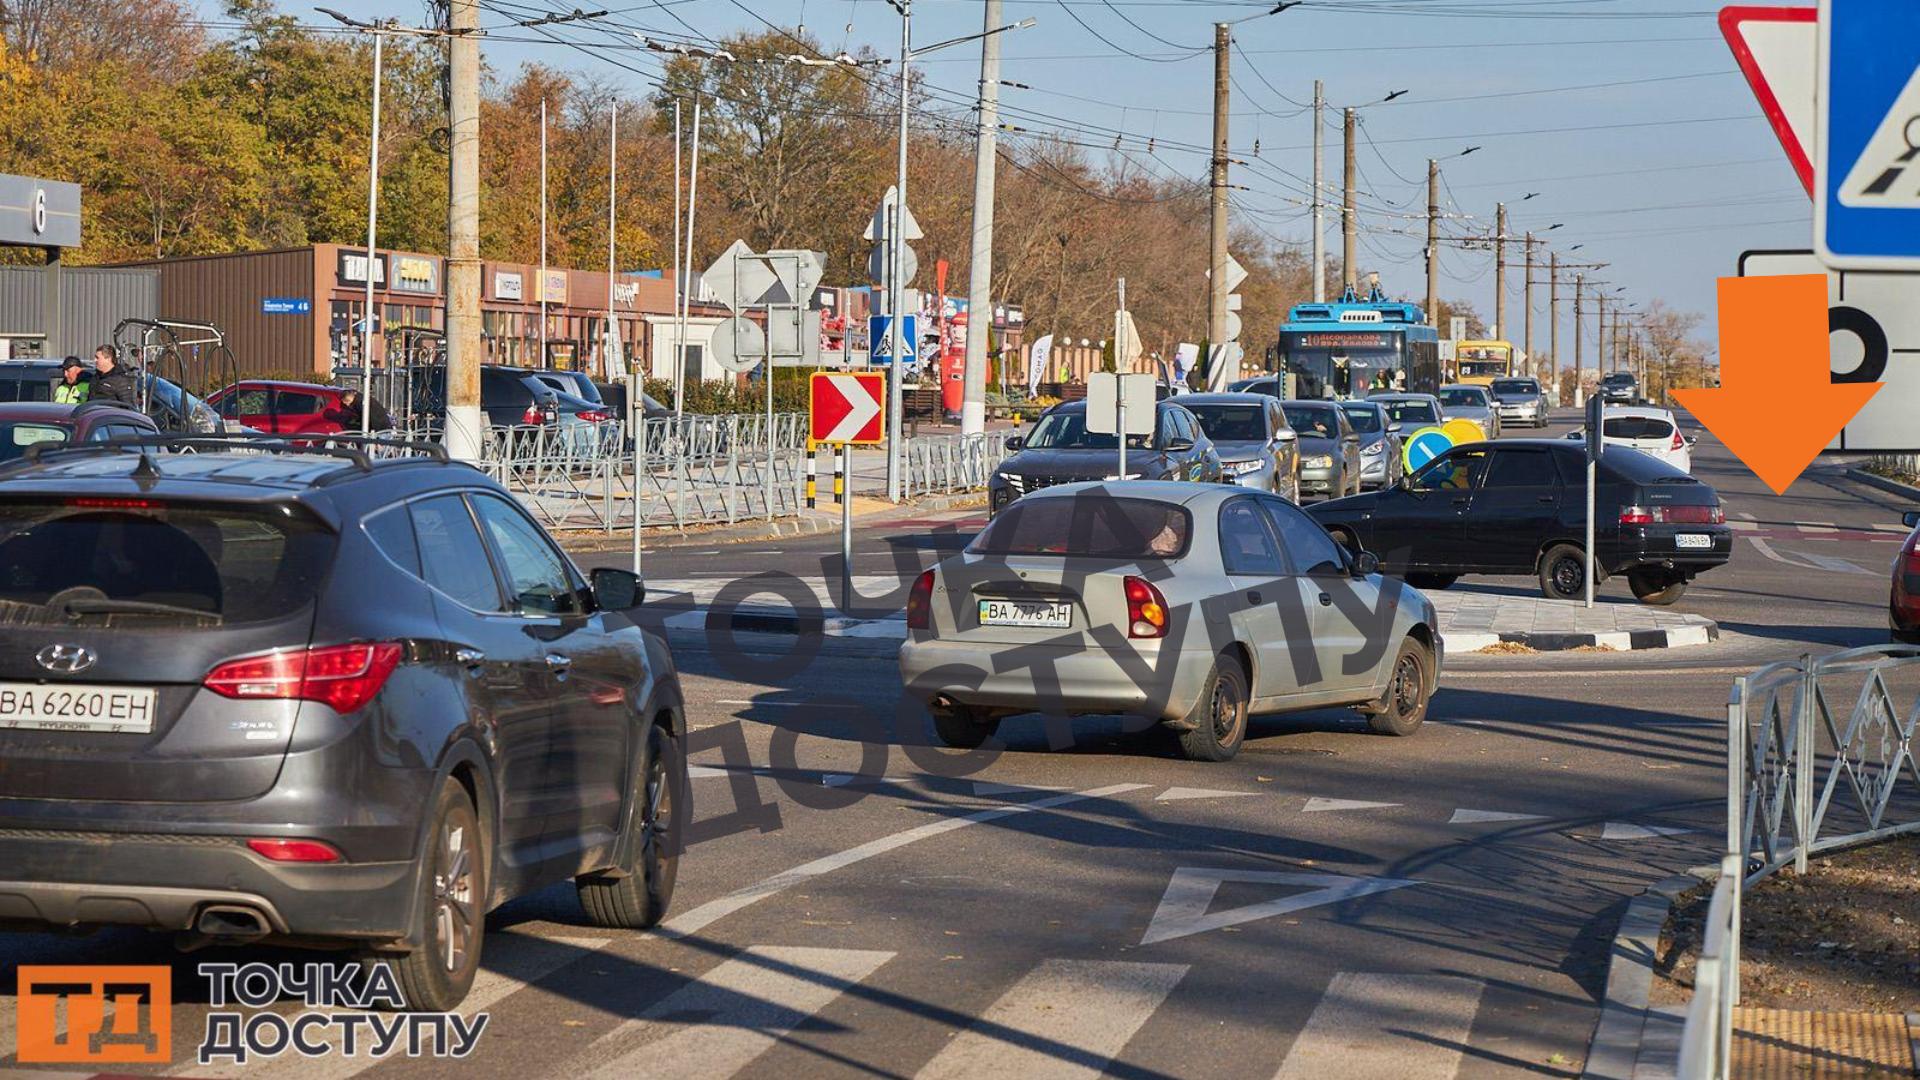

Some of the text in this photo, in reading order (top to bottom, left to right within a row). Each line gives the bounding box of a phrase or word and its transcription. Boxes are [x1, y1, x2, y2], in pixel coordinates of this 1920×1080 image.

[32, 188, 46, 235] 6
[1307, 334, 1320, 346] 10
[1012, 605, 1043, 620] 7776
[43, 692, 103, 717] 6260
